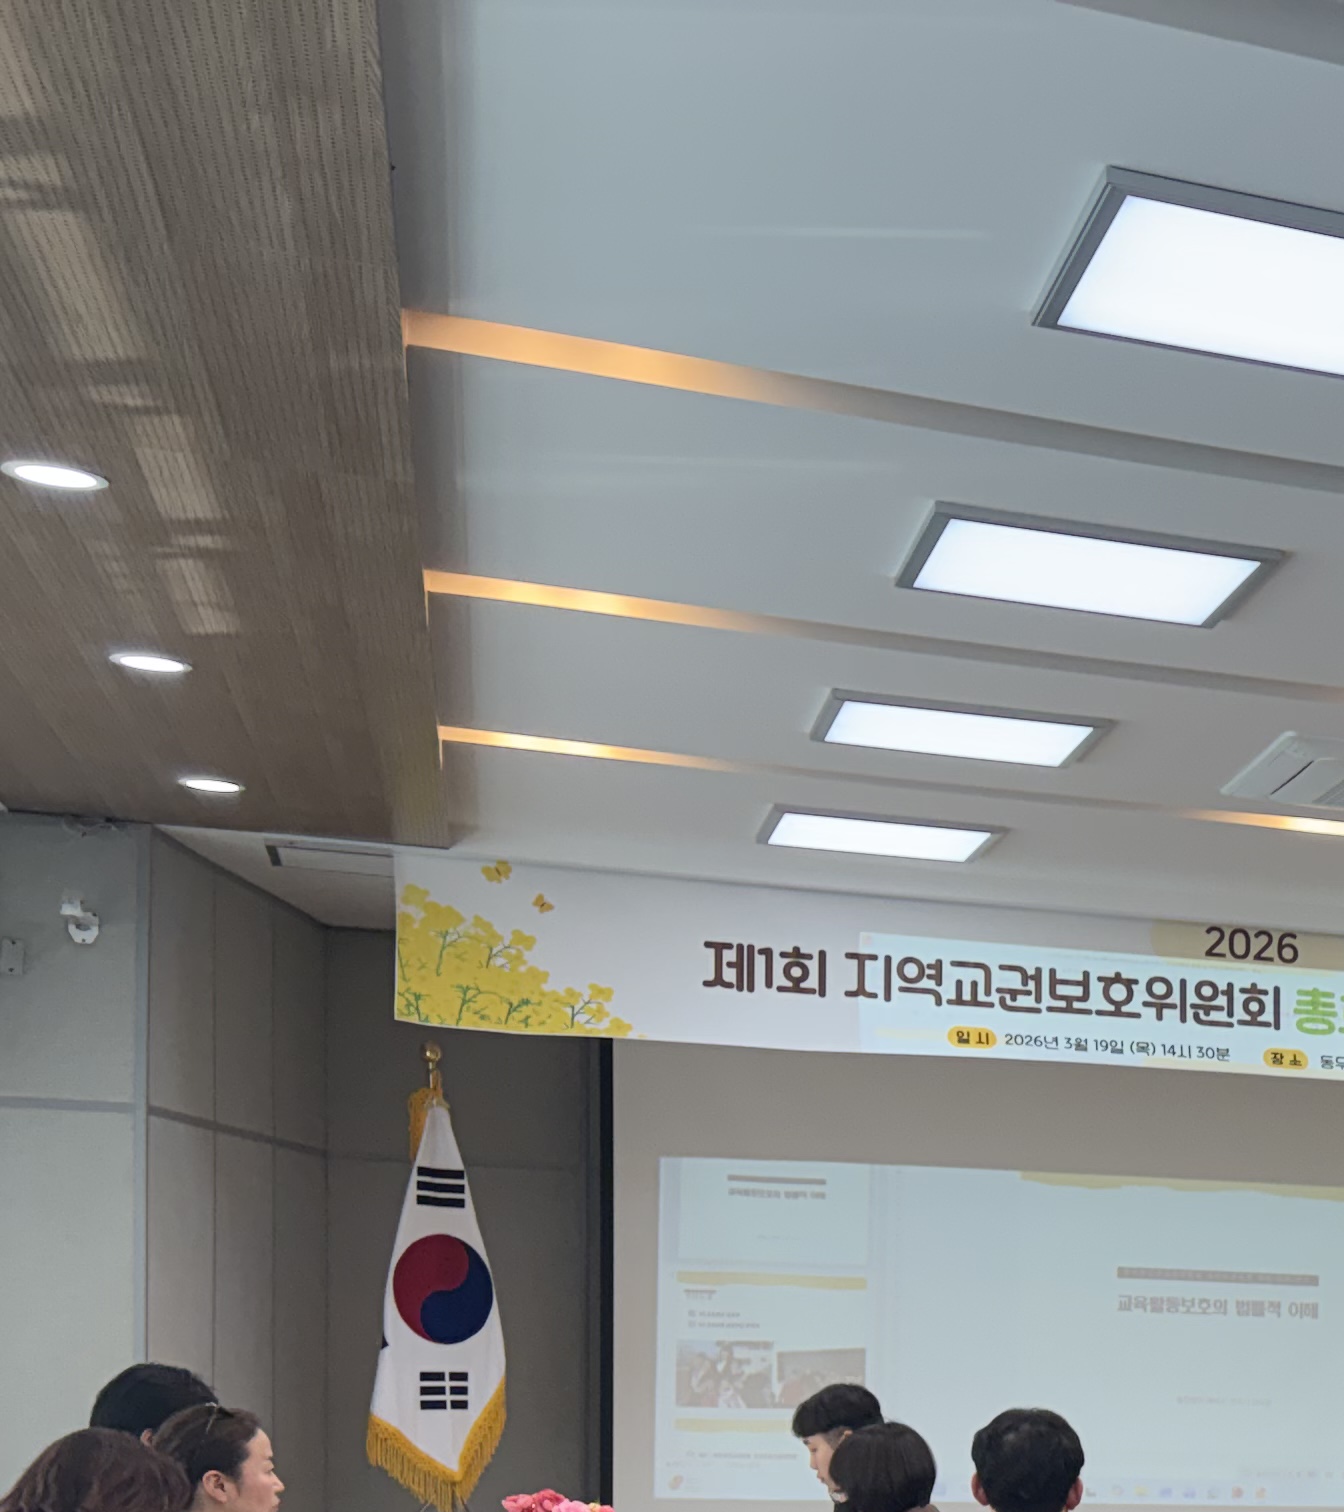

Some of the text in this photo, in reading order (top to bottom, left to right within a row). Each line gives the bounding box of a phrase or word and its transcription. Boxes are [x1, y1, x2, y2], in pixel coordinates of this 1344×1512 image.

[1204, 926, 1300, 964] 2026
[702, 940, 827, 998] 제1회
[844, 951, 1282, 1031] 지역교권보호위원회
[1004, 1033, 1231, 1062] 2026년 3월 19일 (목) 14시 30분
[1288, 1302, 1319, 1320] 이해
